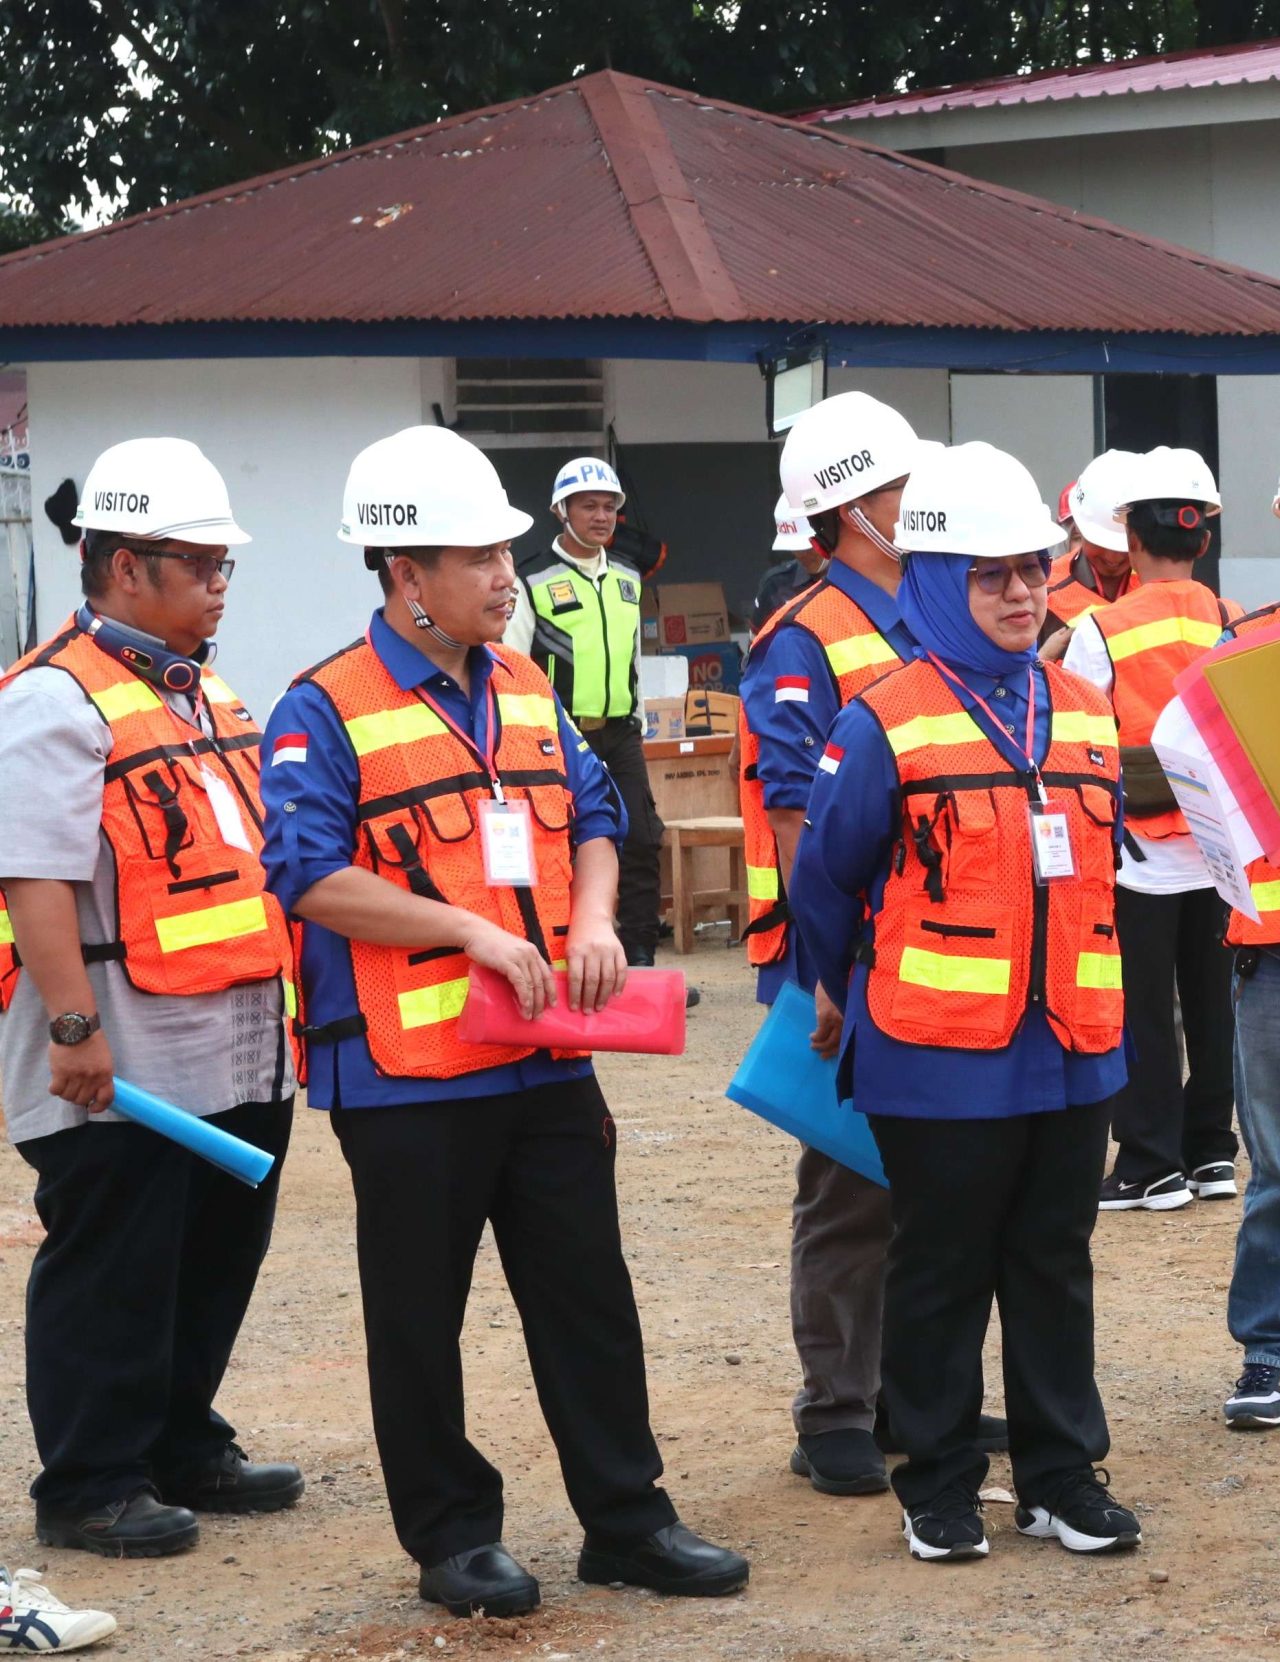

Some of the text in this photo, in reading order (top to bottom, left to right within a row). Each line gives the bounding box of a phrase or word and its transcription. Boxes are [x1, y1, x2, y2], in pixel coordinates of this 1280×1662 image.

[814, 449, 875, 490] VISITOR
[95, 491, 150, 514] VISITOR
[357, 502, 418, 526] VISITOR
[902, 511, 947, 532] VISITOR
[693, 661, 722, 682] NO
